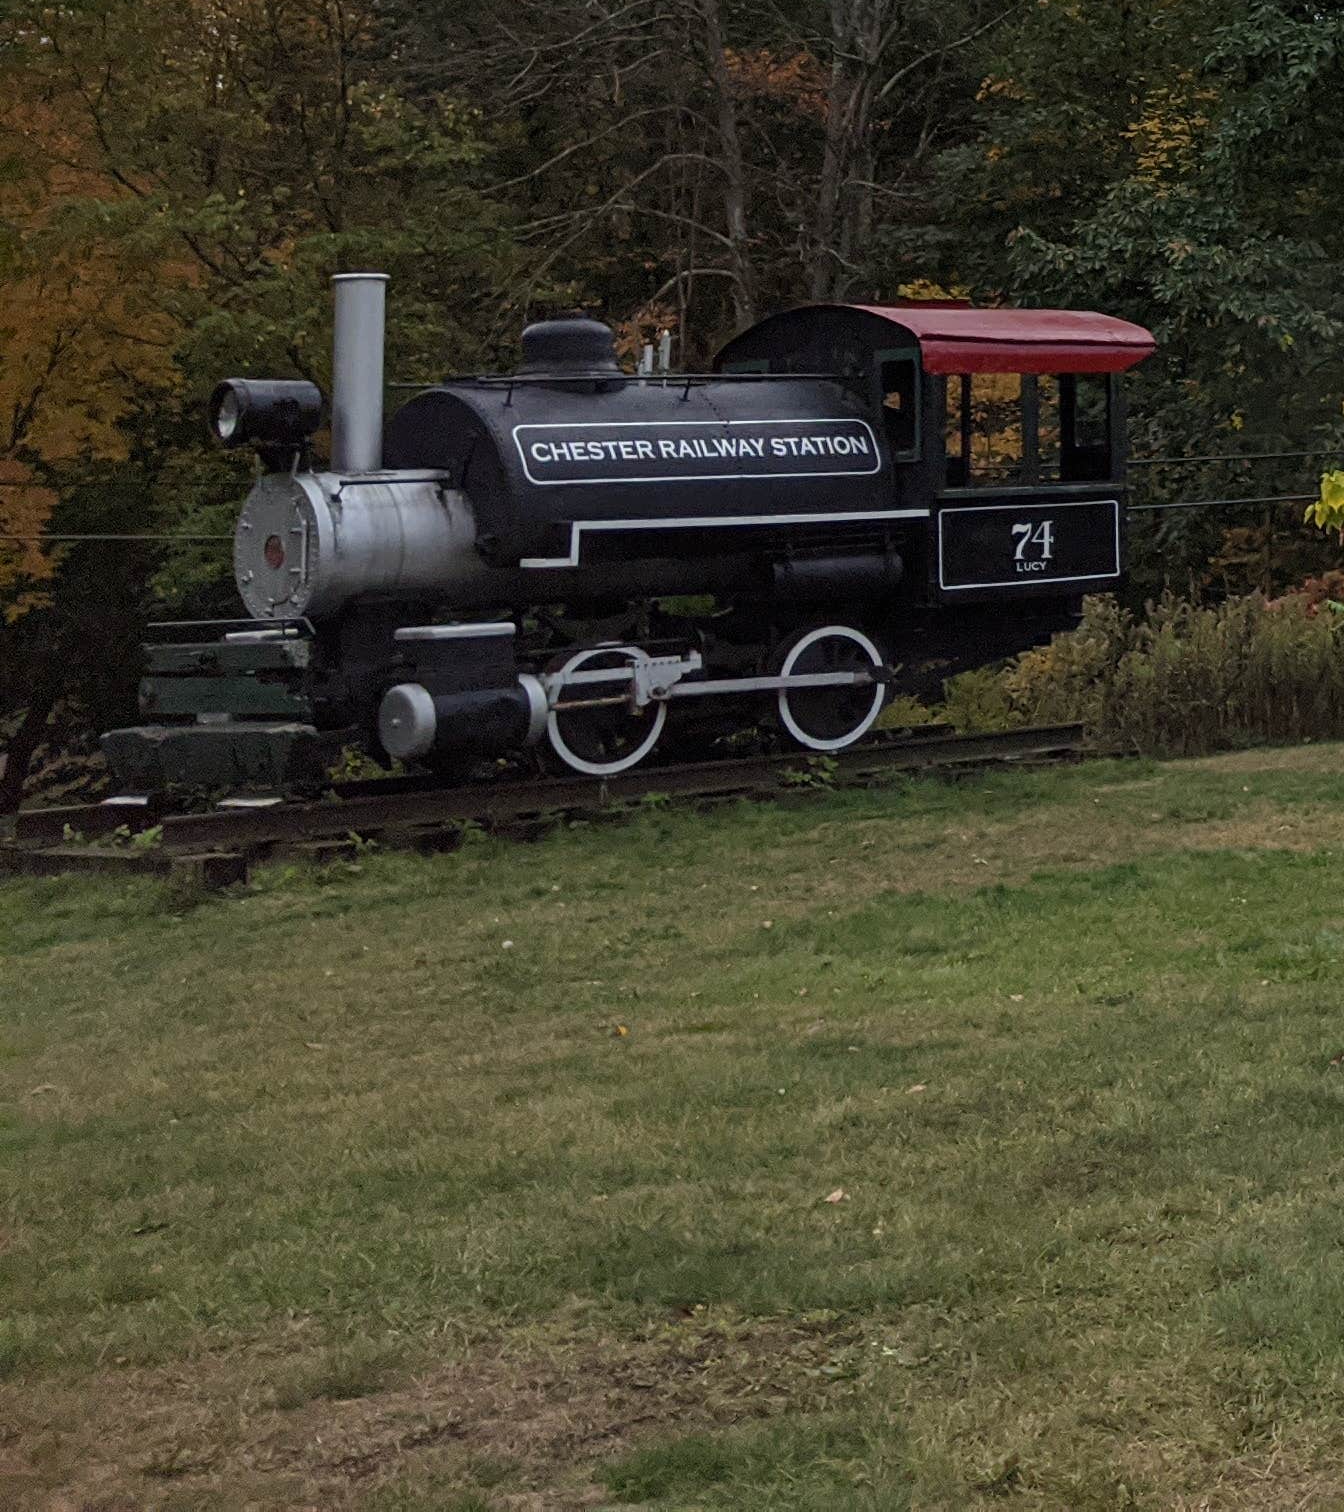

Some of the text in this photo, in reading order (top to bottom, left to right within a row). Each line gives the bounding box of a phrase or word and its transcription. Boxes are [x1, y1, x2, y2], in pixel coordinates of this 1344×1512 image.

[531, 435, 869, 462] CHESTER RAILWAY STATION
[1011, 520, 1054, 559] 74
[1016, 561, 1047, 572] LUCY
